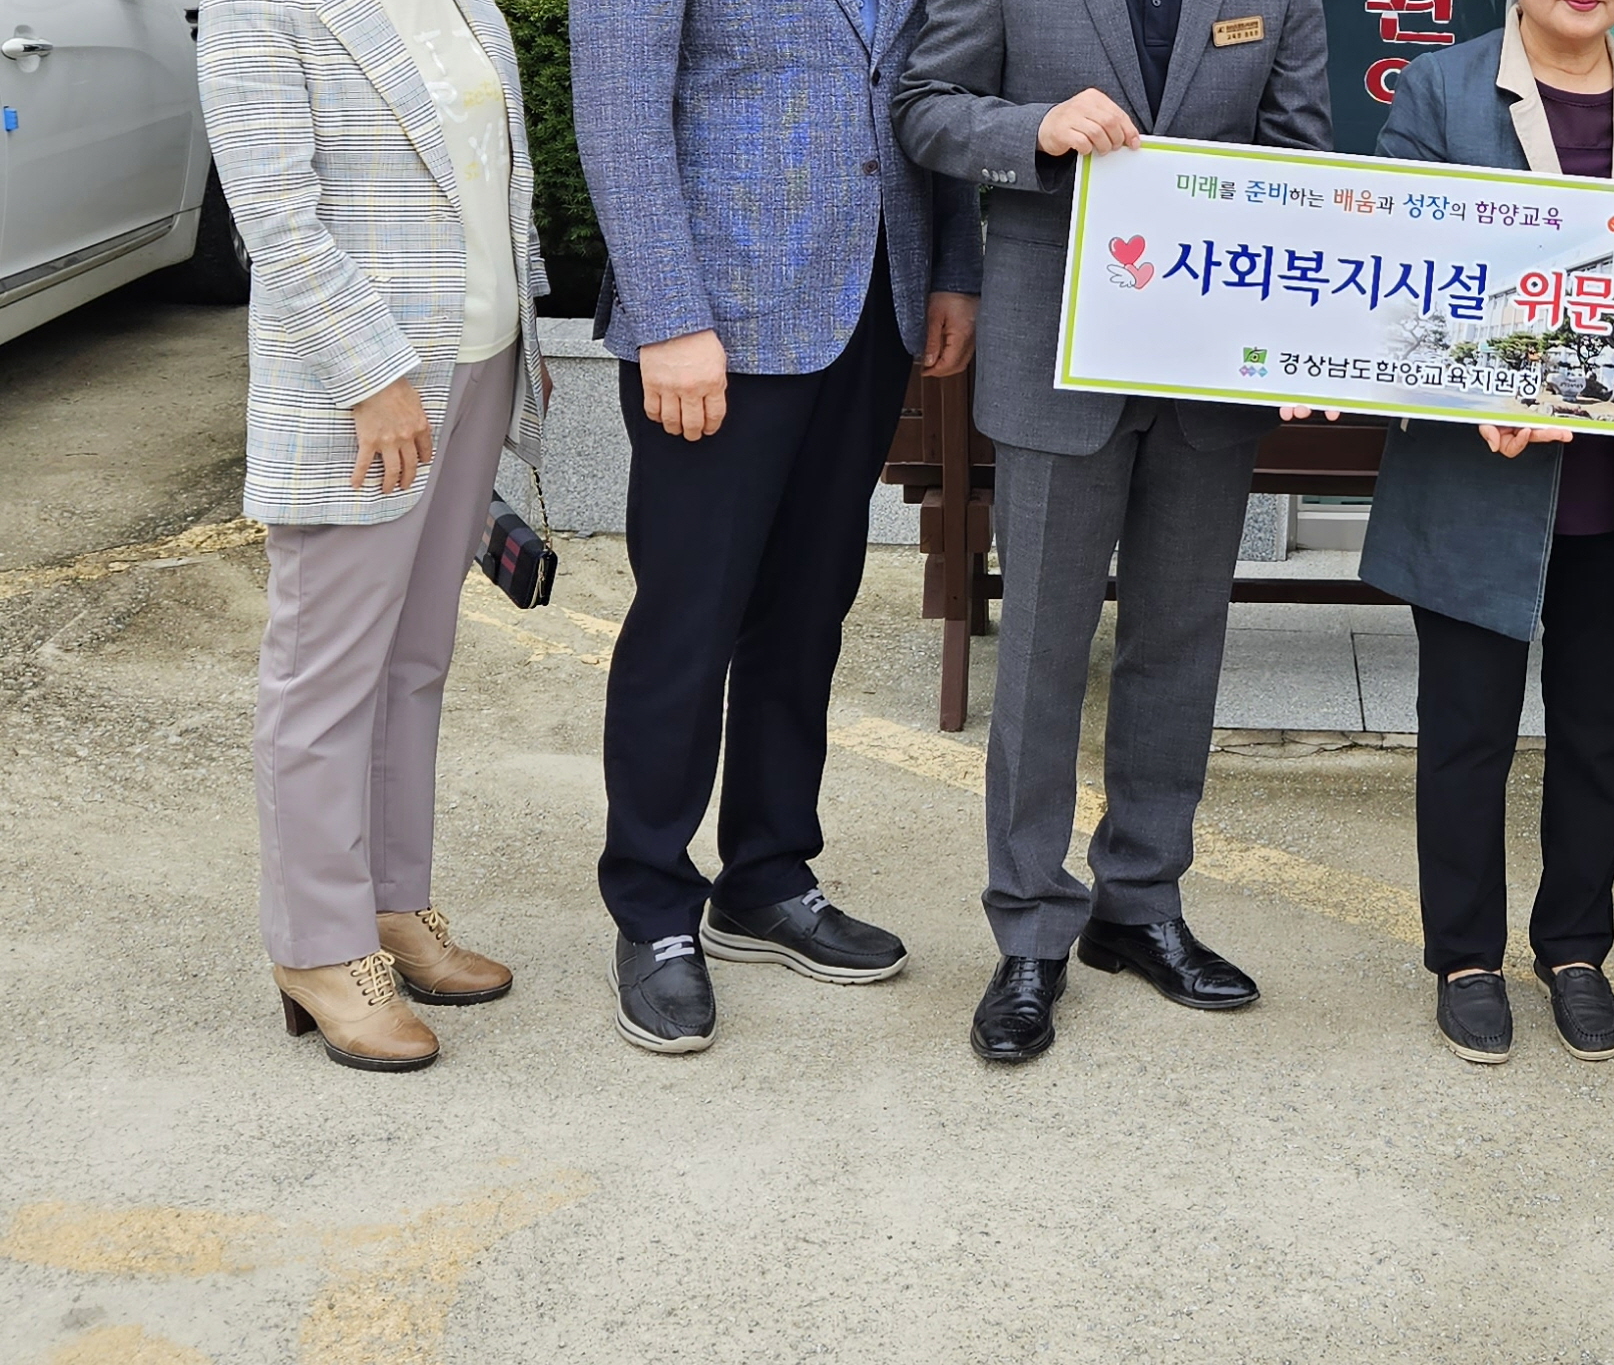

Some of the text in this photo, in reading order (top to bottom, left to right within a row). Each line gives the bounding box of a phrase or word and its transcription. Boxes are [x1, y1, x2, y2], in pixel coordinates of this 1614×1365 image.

[1176, 173, 1564, 231] 미래를 준비하는 배움과 성장의 함양교육
[1162, 239, 1488, 322] 사회복지시설
[1278, 351, 1543, 399] 경상남도함양교육지원청
